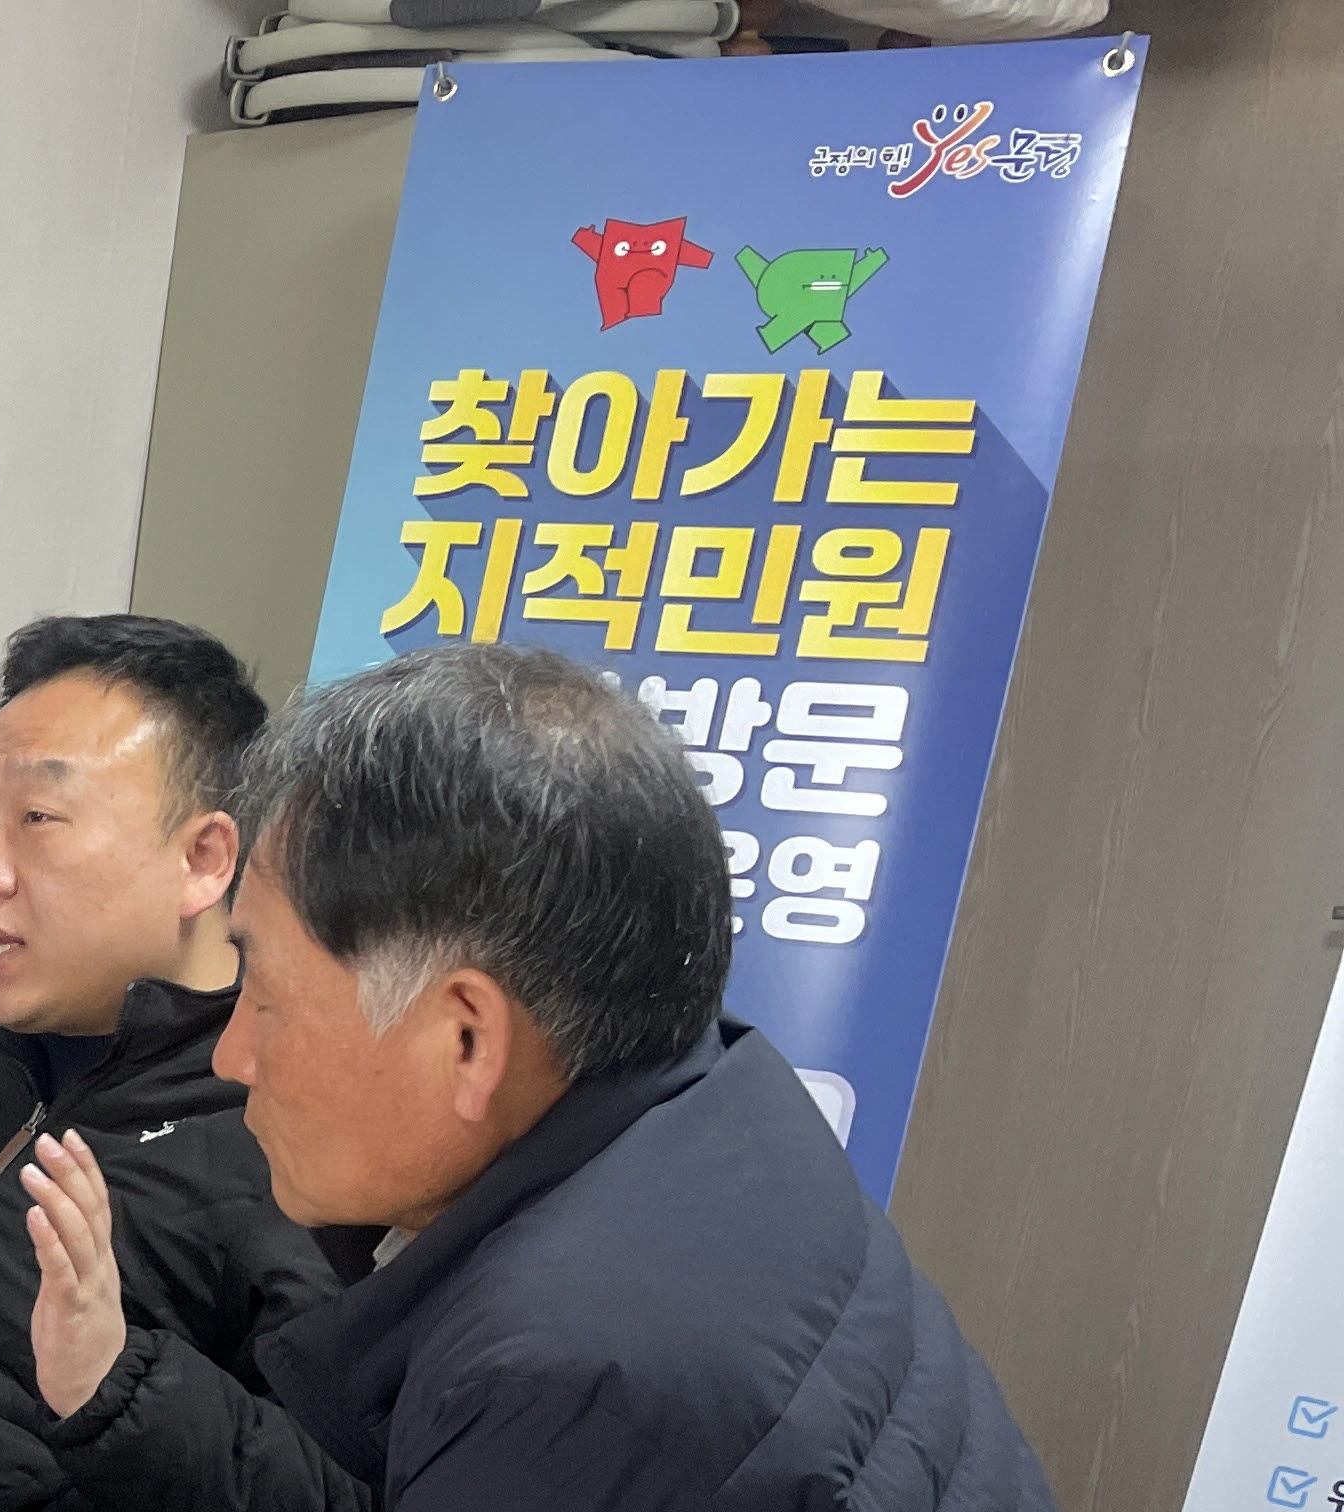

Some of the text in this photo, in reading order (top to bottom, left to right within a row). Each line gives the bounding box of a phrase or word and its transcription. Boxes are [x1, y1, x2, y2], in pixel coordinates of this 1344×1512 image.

[810, 146, 877, 177] 긍정의
[879, 143, 913, 175] 힘!
[889, 101, 1001, 199] Yes
[412, 368, 977, 507] 찾아가는
[380, 518, 952, 663] 지적민원
